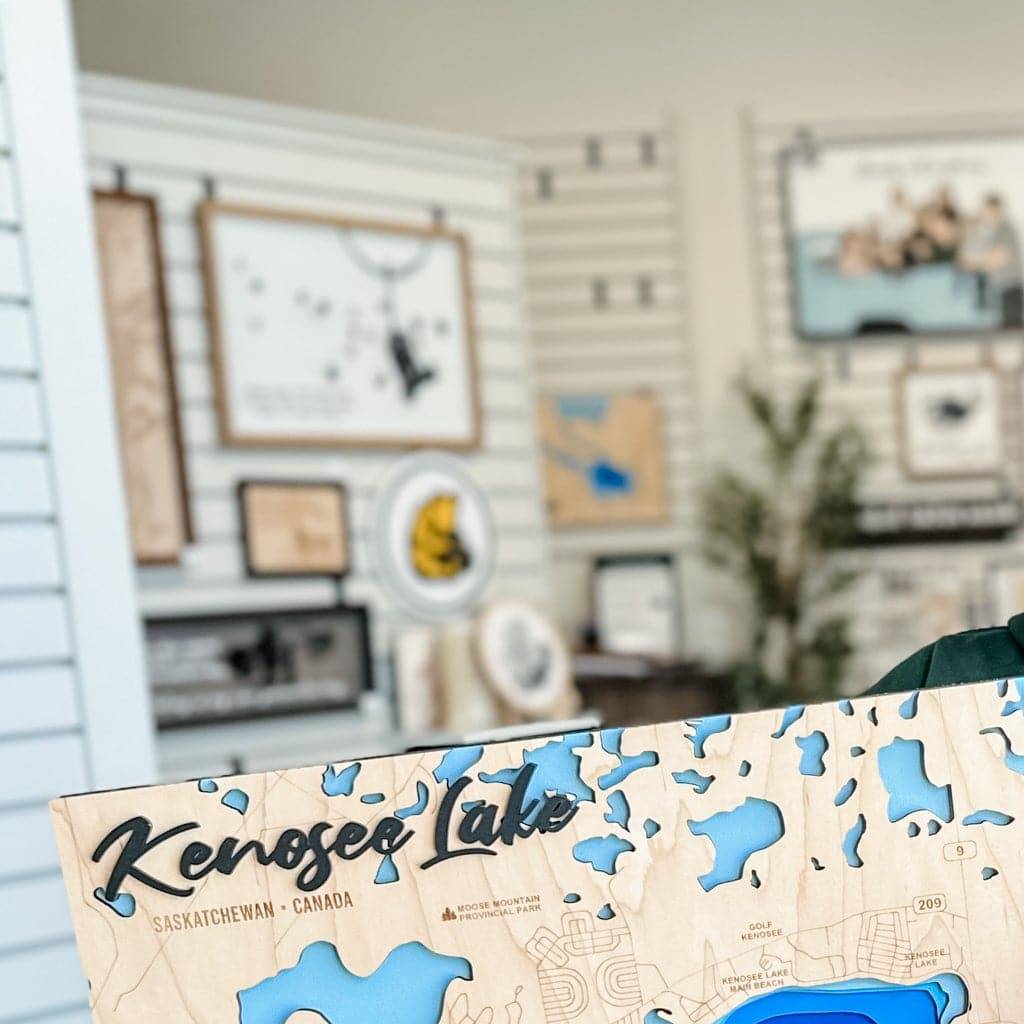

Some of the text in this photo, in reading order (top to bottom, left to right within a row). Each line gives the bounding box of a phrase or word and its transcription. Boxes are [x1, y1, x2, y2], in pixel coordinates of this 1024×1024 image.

[92, 763, 579, 902] Kenosee Lake
[956, 846, 964, 856] 9
[457, 895, 541, 912] MOOSE MOUNTAIN
[918, 898, 942, 911] 209
[153, 891, 354, 933] SASKATCHEWAN CANADA
[459, 904, 542, 921] PROVINCIAL PARK
[749, 921, 772, 931] GOLF
[741, 928, 784, 941] KENOSEE
[904, 949, 945, 961] KENOSEE
[915, 959, 937, 969] LAKE
[722, 968, 789, 985] KENOSEE LAKE
[729, 979, 784, 993] MAIN BEACH
